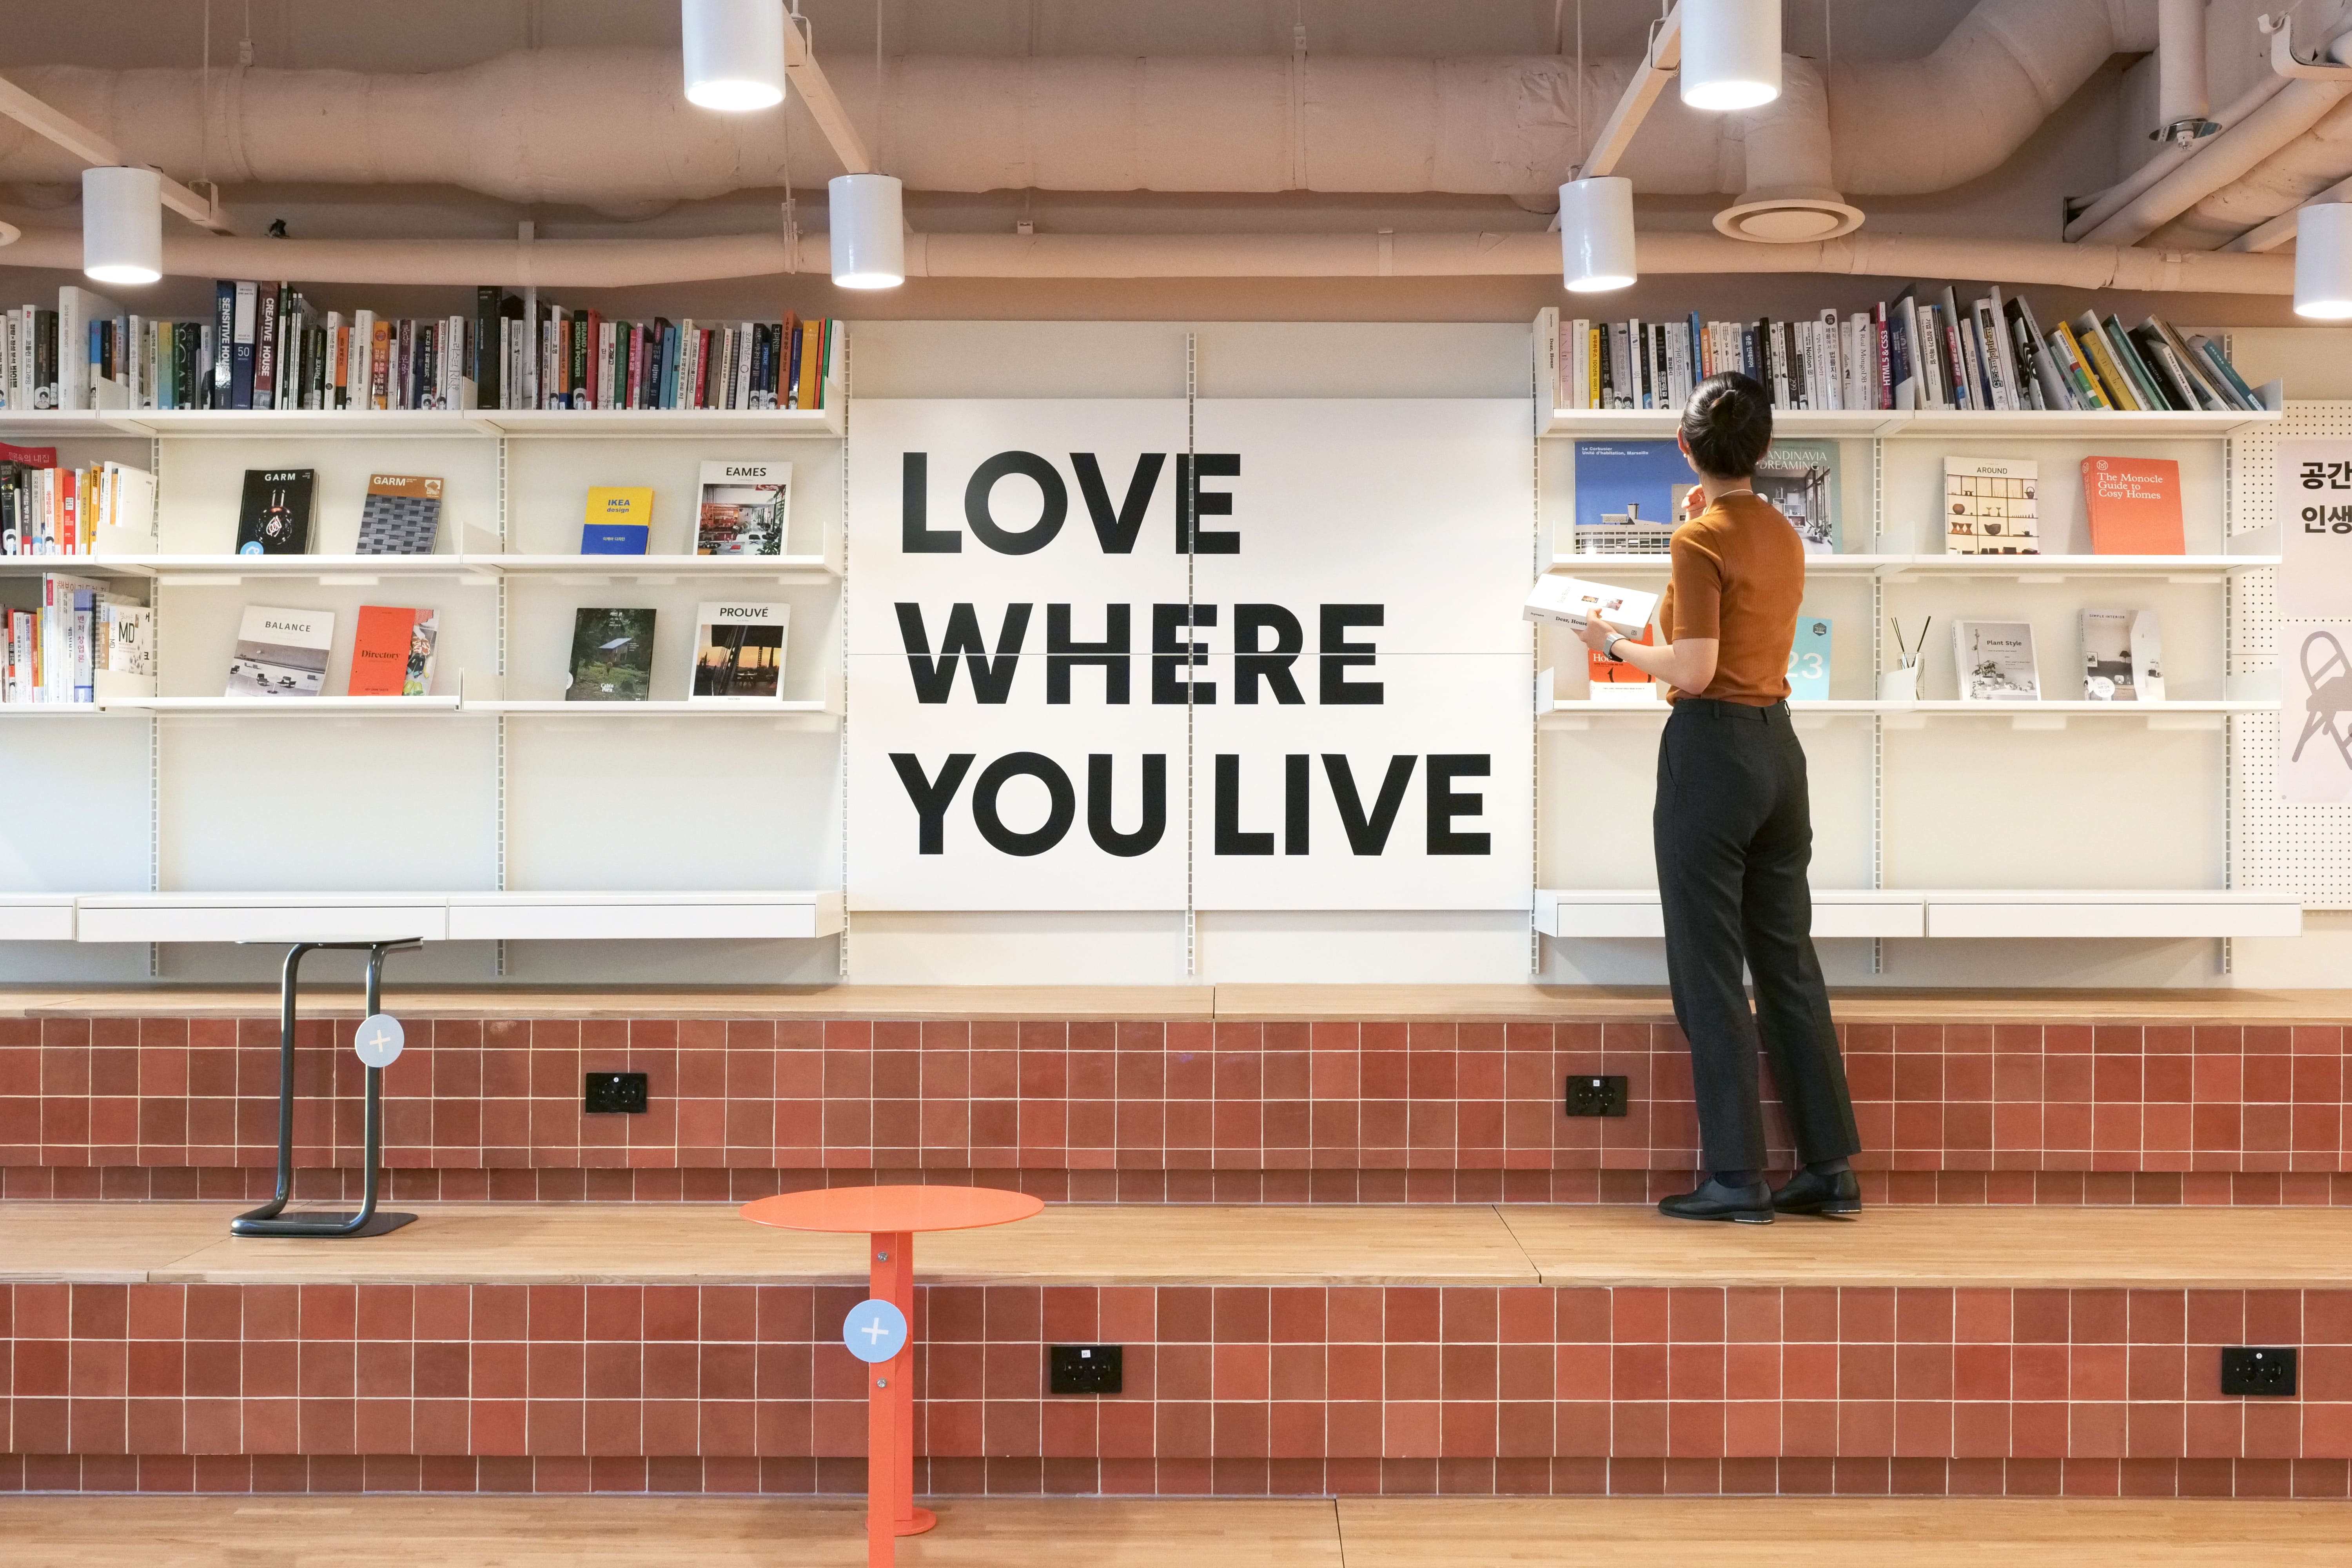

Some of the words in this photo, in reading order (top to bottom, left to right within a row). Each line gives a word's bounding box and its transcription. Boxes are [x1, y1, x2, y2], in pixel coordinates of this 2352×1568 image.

[222, 298, 230, 344] SENSITIVE
[263, 298, 274, 341] CREATIVE
[1925, 319, 1932, 329] 기업
[1745, 335, 1753, 346] 생존
[2036, 333, 2044, 350] Collection
[238, 347, 250, 357] 50
[552, 343, 558, 354] 조명
[261, 345, 271, 377] HOUSE
[452, 343, 461, 368] 리스크
[753, 359, 760, 370] 전략
[1882, 357, 1890, 386] HTML5
[449, 370, 461, 390] Risk
[1766, 450, 1827, 461] ANDINAVIA
[1760, 460, 1820, 471] DREAMING
[265, 473, 296, 481] GARM
[726, 467, 767, 476] EAMES
[2300, 461, 2352, 490] 공간
[374, 476, 406, 486] GARM
[2097, 472, 2117, 481] The
[2121, 473, 2164, 483] Monocle
[2098, 481, 2128, 490] Guide
[2098, 488, 2123, 499] Cosy
[2126, 490, 2161, 499] Homes
[903, 451, 1240, 555] LOVE
[2301, 505, 2352, 534] 인생
[719, 607, 769, 618] PROUVÉ
[78, 615, 85, 633] 벤처
[265, 621, 311, 632] BALANCE
[119, 621, 135, 643] MD
[110, 639, 116, 649] MD
[361, 650, 400, 660] Directory
[894, 603, 1384, 704] WHERE
[1788, 653, 1823, 679] 23
[888, 752, 1166, 857] YOU
[1215, 754, 1490, 856] LIVE
